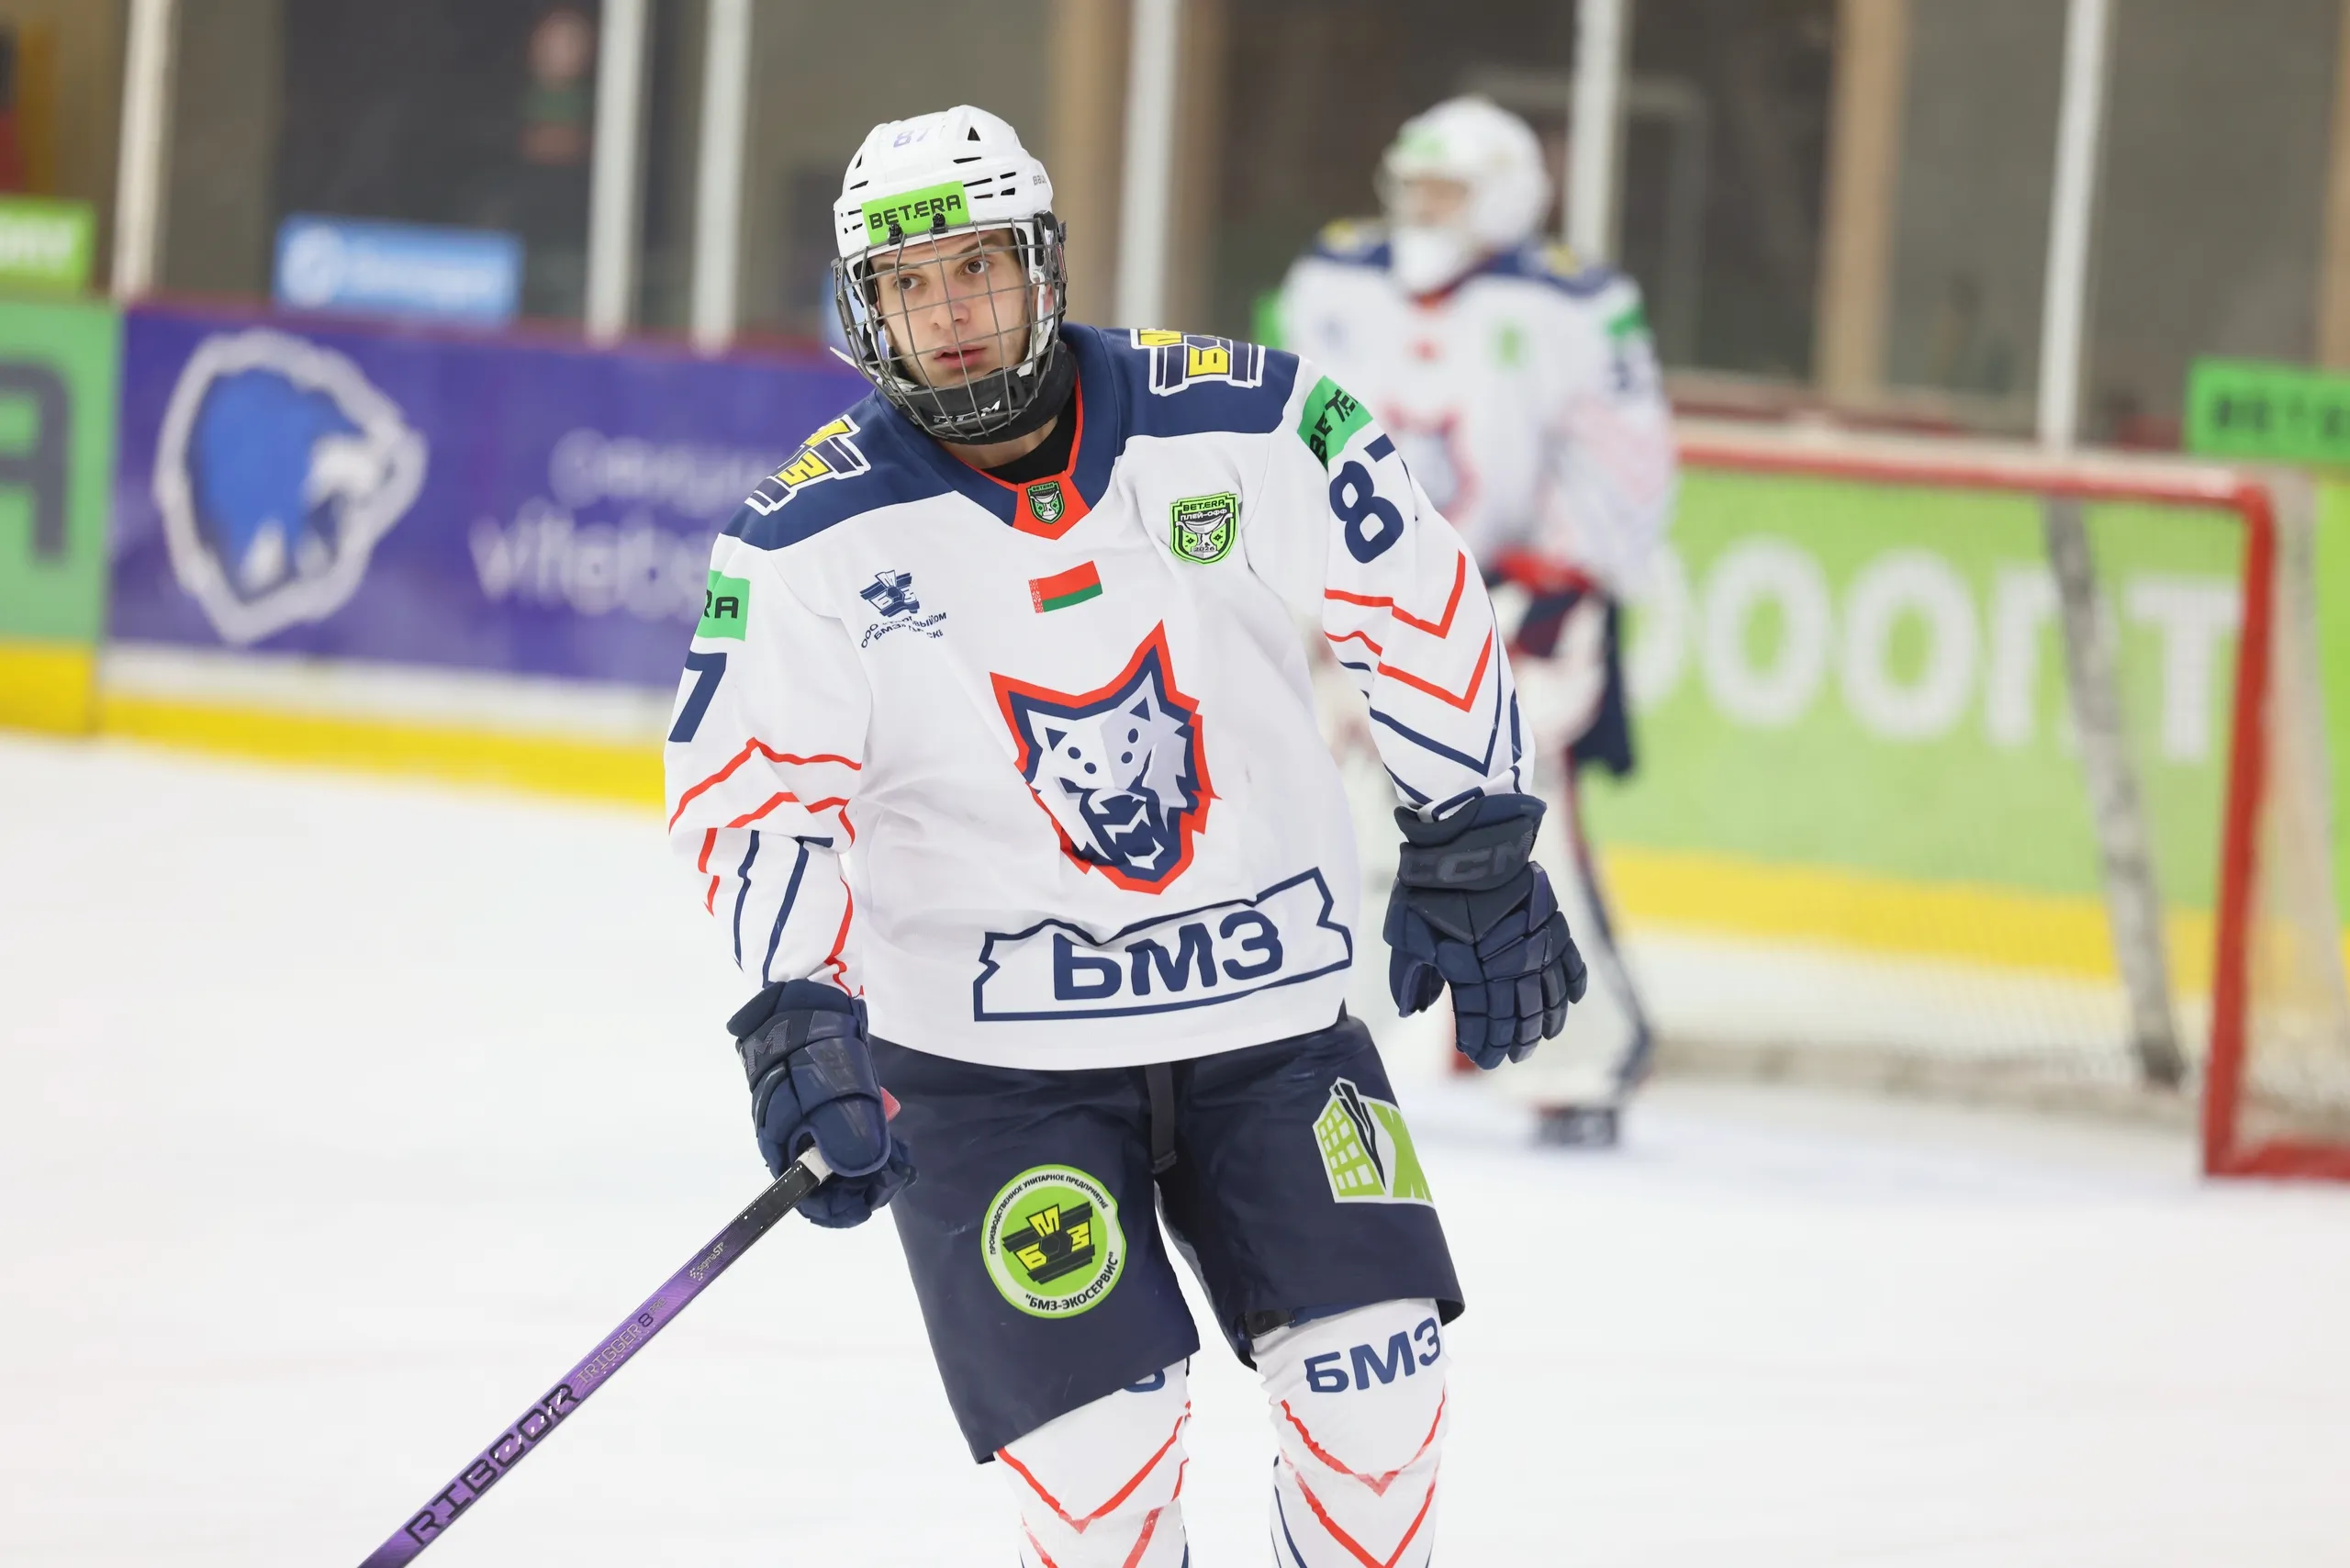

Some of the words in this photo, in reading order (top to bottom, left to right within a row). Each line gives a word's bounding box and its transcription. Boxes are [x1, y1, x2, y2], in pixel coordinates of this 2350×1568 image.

[1181, 509, 1227, 521] ПЛЕЙ-ОФФ
[1053, 910, 1283, 1001] БМЗ
[990, 1184, 1024, 1255] ПРОИЗВОДСТВЕННОЕ
[1023, 1174, 1065, 1189] УНИТАРНОЕ
[1066, 1175, 1109, 1210] ПРЕДПРИЯТИЕ
[1304, 1316, 1441, 1394] БМЗ
[405, 1383, 580, 1546] RIBCOR
[576, 1323, 642, 1384] TRIGGER
[638, 1313, 654, 1327] 8
